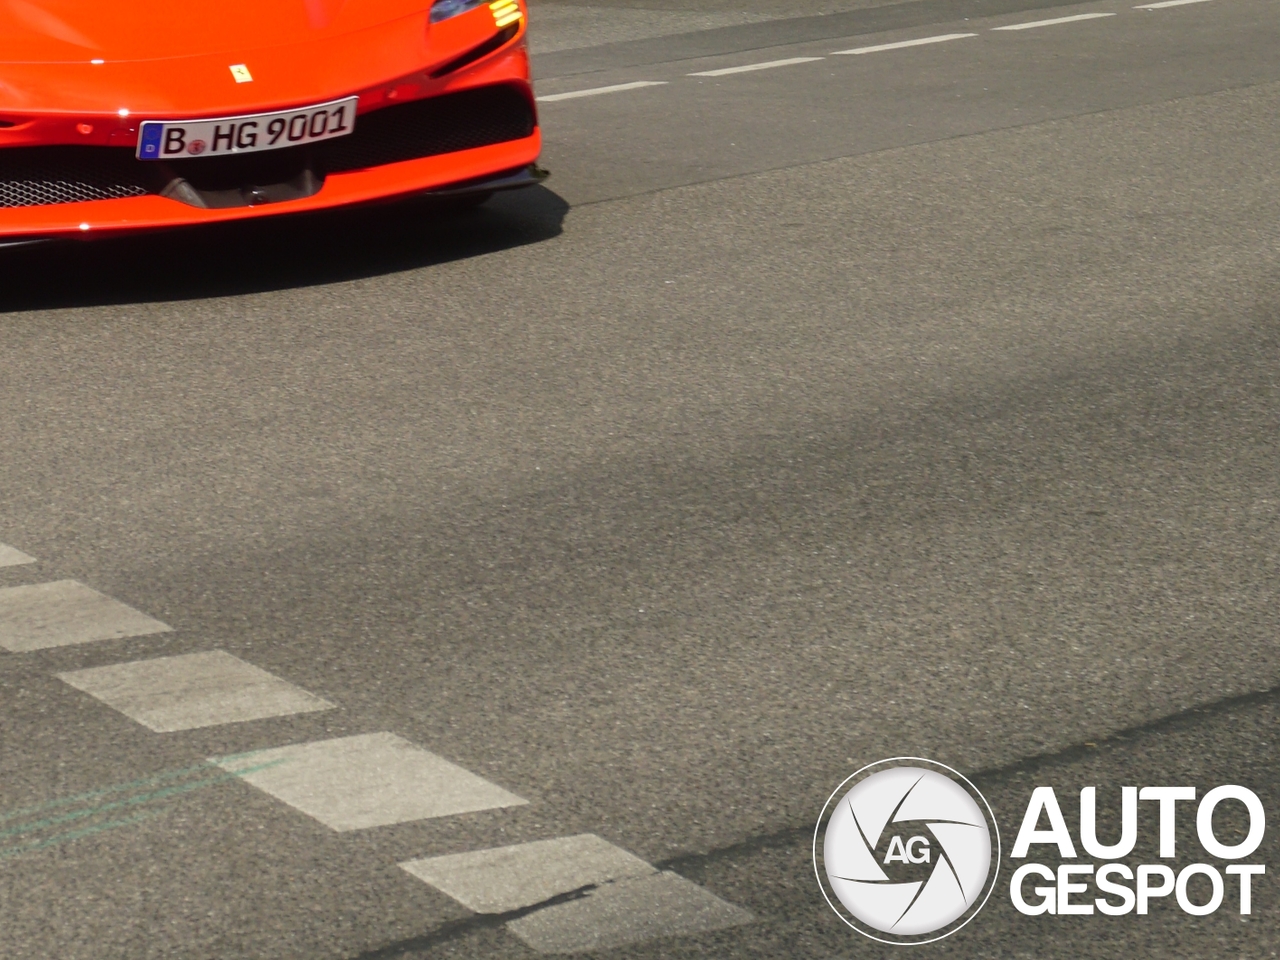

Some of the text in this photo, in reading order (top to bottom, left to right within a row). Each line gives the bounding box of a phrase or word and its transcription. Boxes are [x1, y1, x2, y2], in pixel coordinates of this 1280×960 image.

[164, 106, 347, 154] B HG 9001
